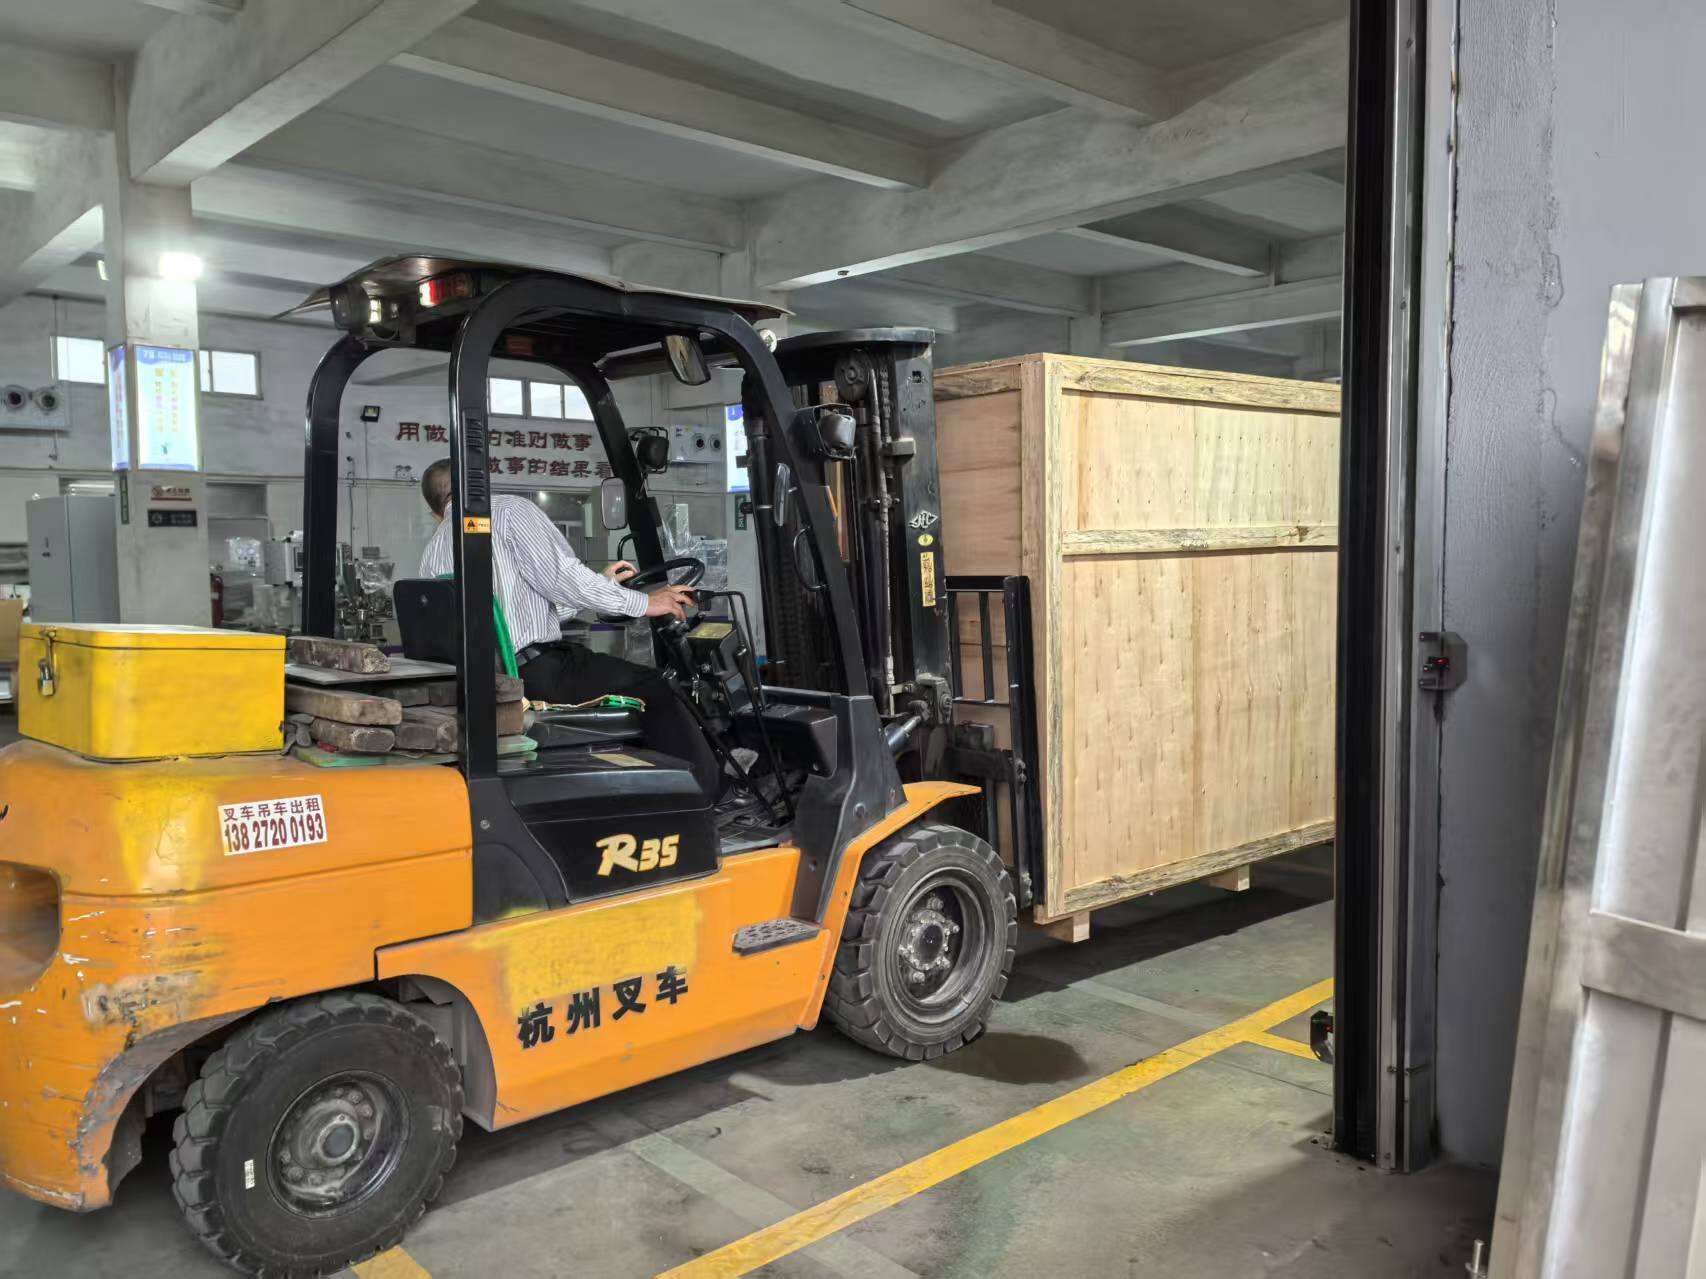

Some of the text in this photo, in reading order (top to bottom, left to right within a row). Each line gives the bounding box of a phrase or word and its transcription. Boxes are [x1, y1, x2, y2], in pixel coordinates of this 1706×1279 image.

[224, 798, 320, 822] 叉车吊车出租
[224, 822, 250, 852] 138
[595, 833, 680, 877] R35
[517, 965, 688, 1049] 杭州叉车
